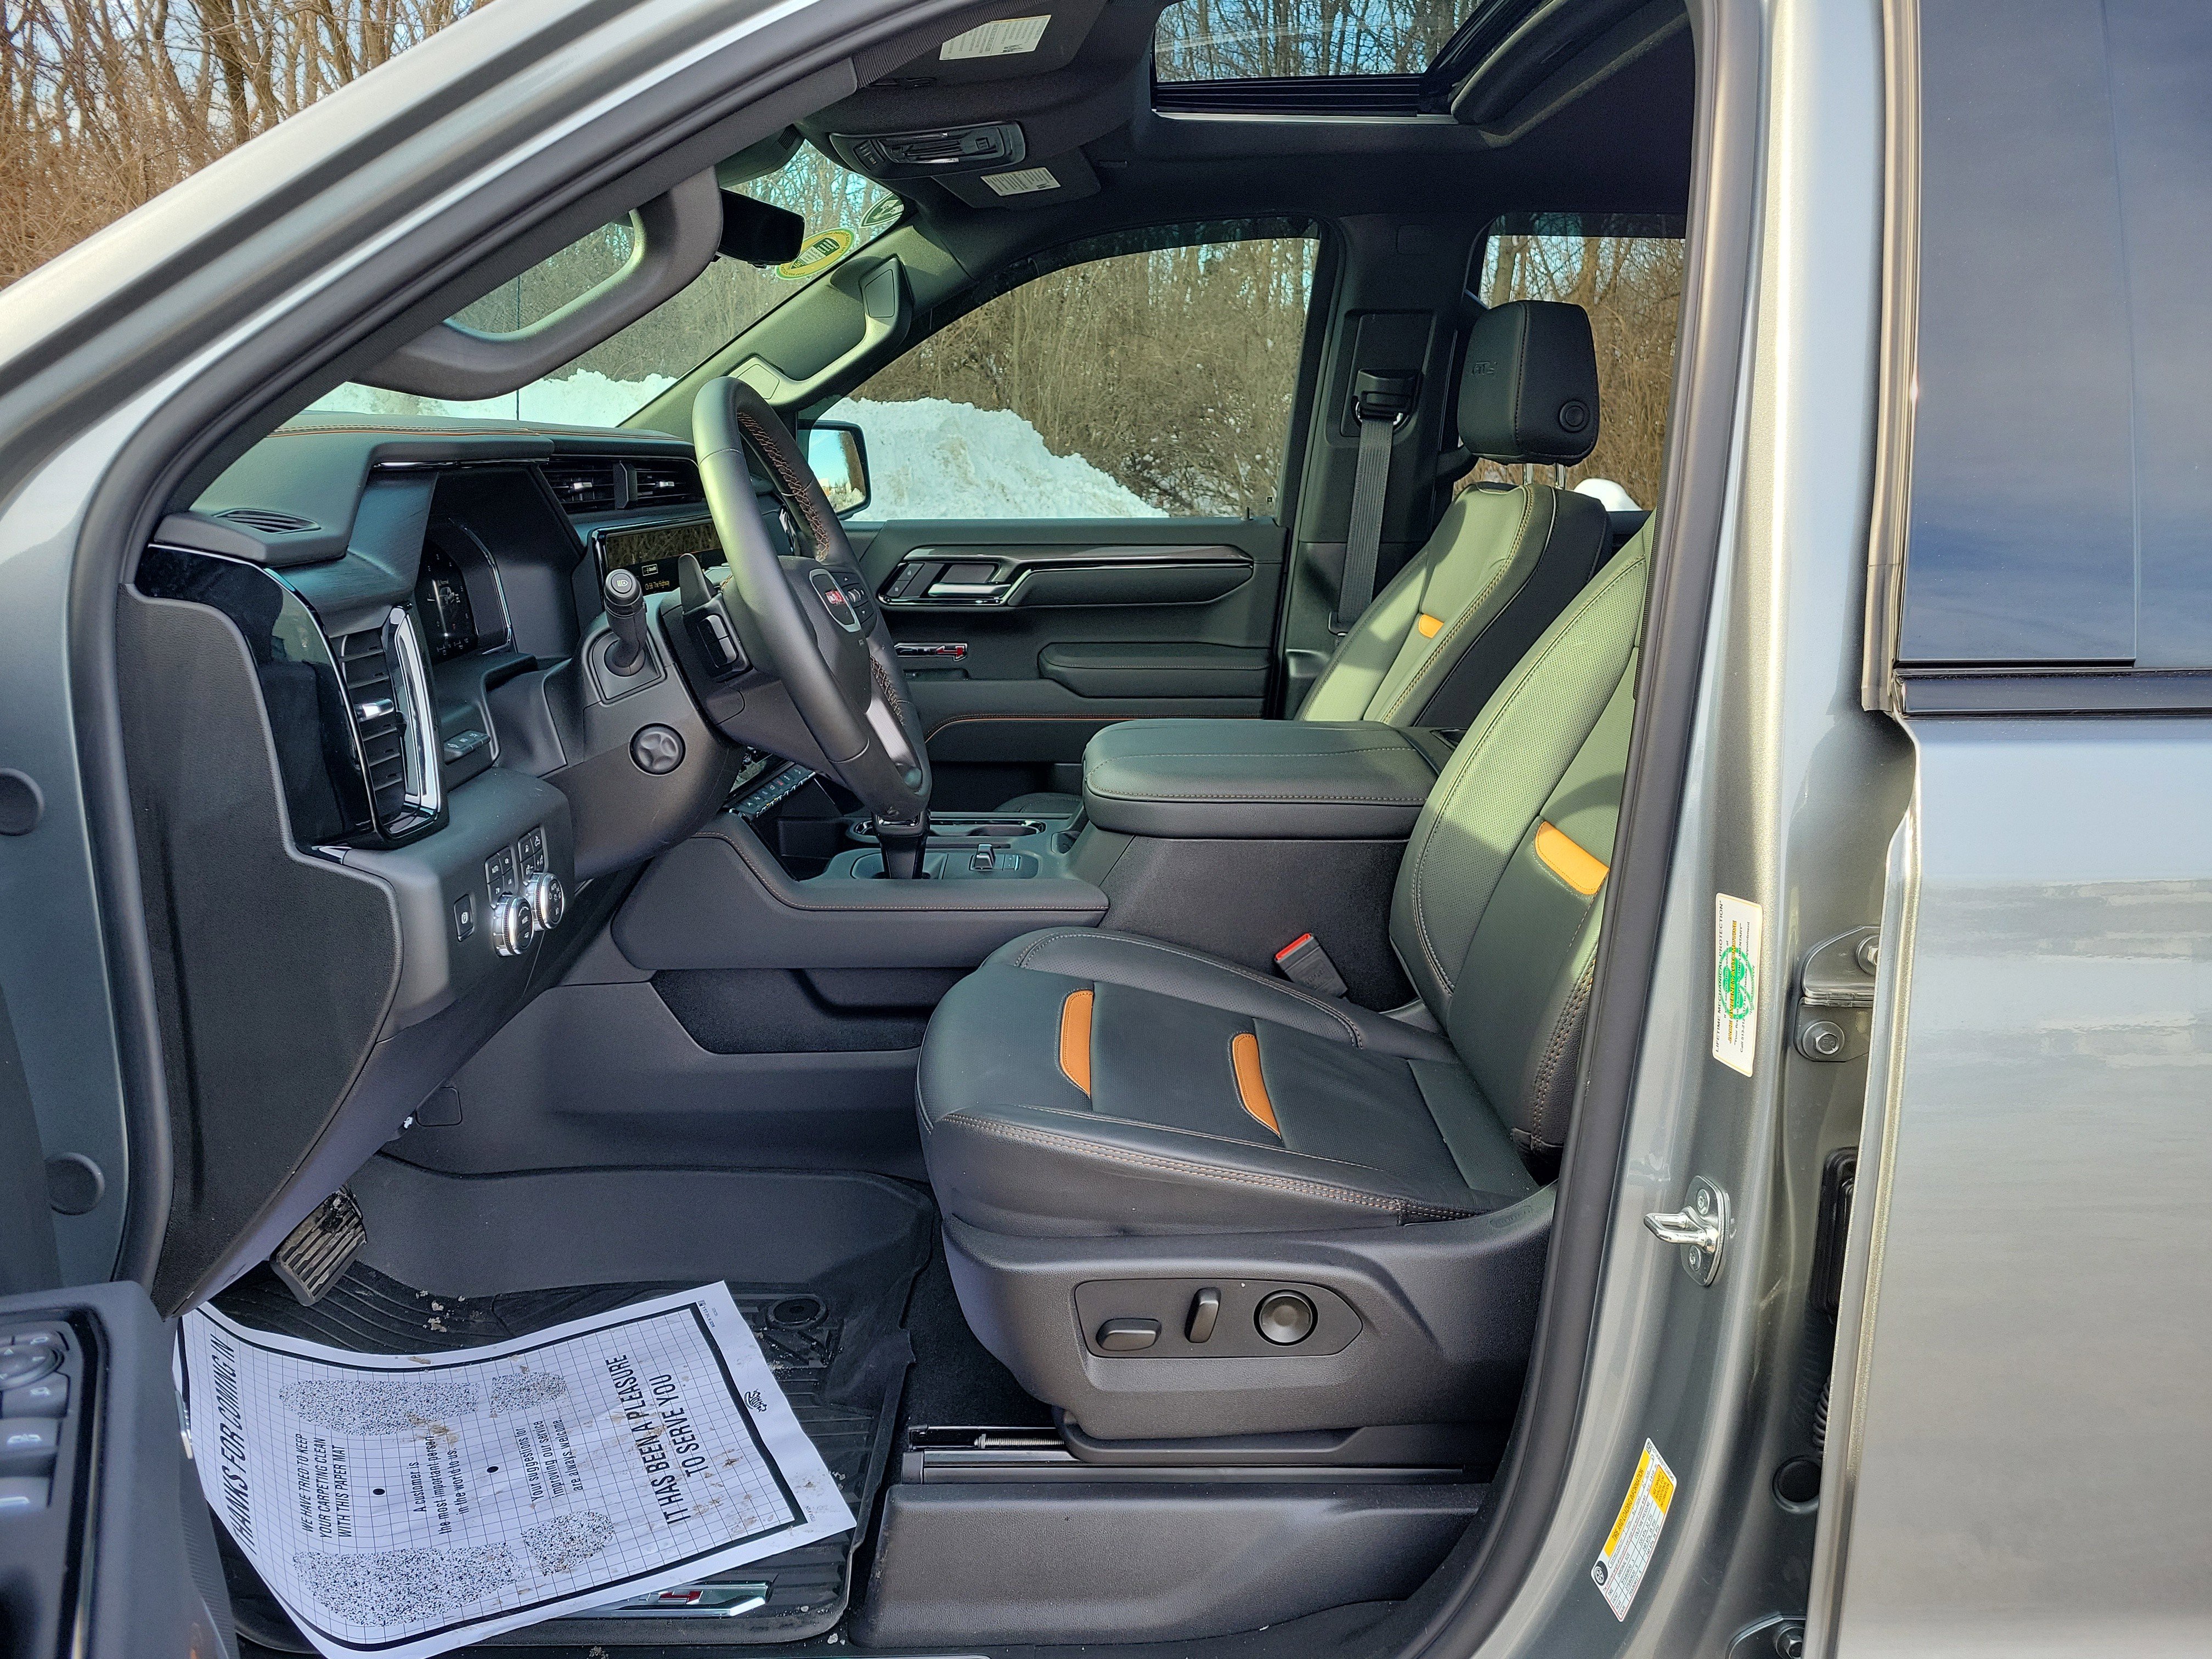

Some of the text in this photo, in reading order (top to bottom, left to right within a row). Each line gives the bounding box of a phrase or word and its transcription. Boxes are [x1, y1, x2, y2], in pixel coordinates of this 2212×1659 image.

[210, 1333, 256, 1555] THANKS FOR COMING IN
[447, 1447, 458, 1459] us.
[533, 1420, 565, 1499] improving our service
[552, 1417, 583, 1491] are always welcome.
[605, 1355, 692, 1525] IT HAS BEEN A PLEASURE
[648, 1374, 709, 1477] TO SERVE YOU
[295, 1434, 313, 1533] WE HAVE TRIED TO KEEP
[313, 1437, 332, 1538] YOUR CARPETING CLEAN
[331, 1445, 352, 1537] WITH THIS PAPER MAT
[407, 1462, 419, 1470] is
[410, 1472, 426, 1505] customer
[425, 1436, 452, 1534] the most important person
[448, 1460, 460, 1469] to
[448, 1469, 465, 1490] world
[453, 1492, 467, 1506] the
[515, 1427, 544, 1502] Your suggestions for
[1621, 1497, 1632, 1521] LOADING
[1628, 1466, 1645, 1502] INFORMATION
